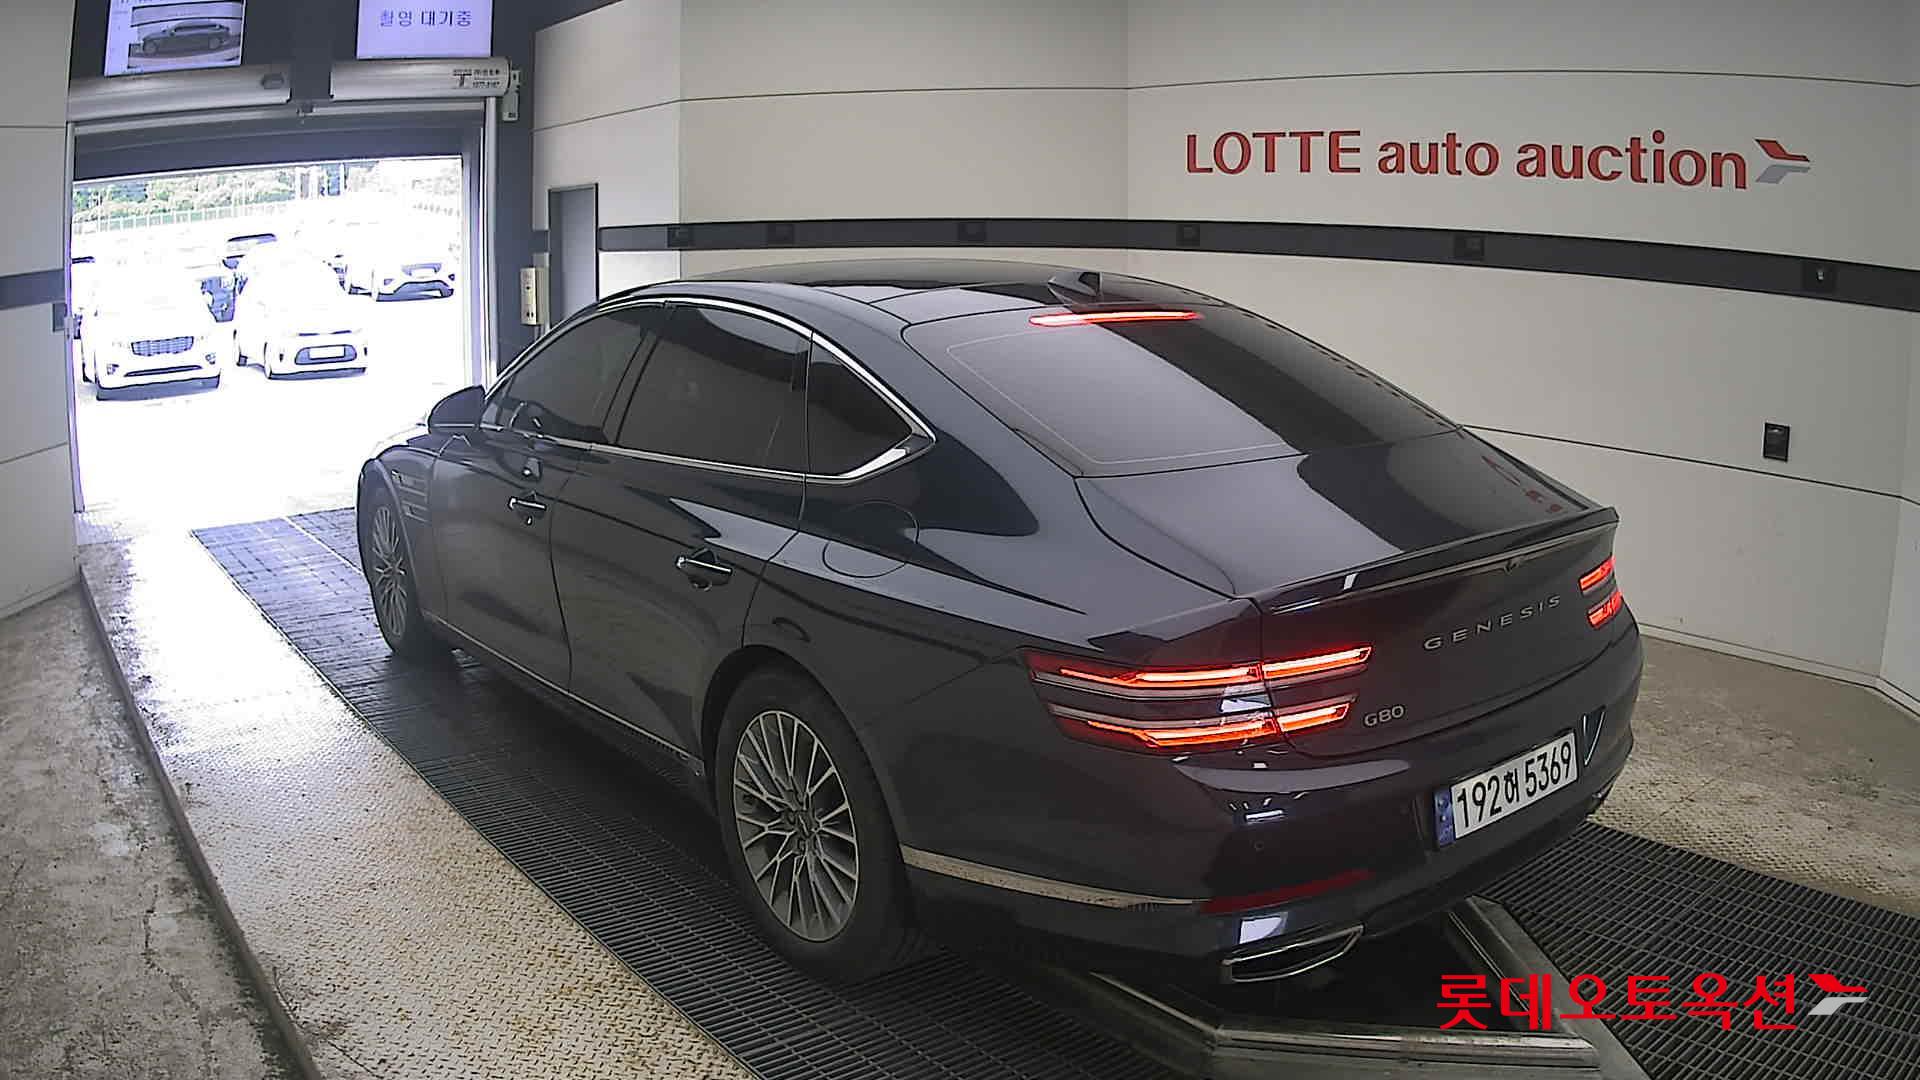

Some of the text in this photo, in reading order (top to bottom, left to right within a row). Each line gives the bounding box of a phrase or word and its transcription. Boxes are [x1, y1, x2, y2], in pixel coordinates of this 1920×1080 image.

[421, 10, 471, 27] 대기중
[1186, 130, 1748, 190] LOTTE auto auction
[1423, 595, 1561, 650] GENESIS
[1363, 705, 1405, 727] G80
